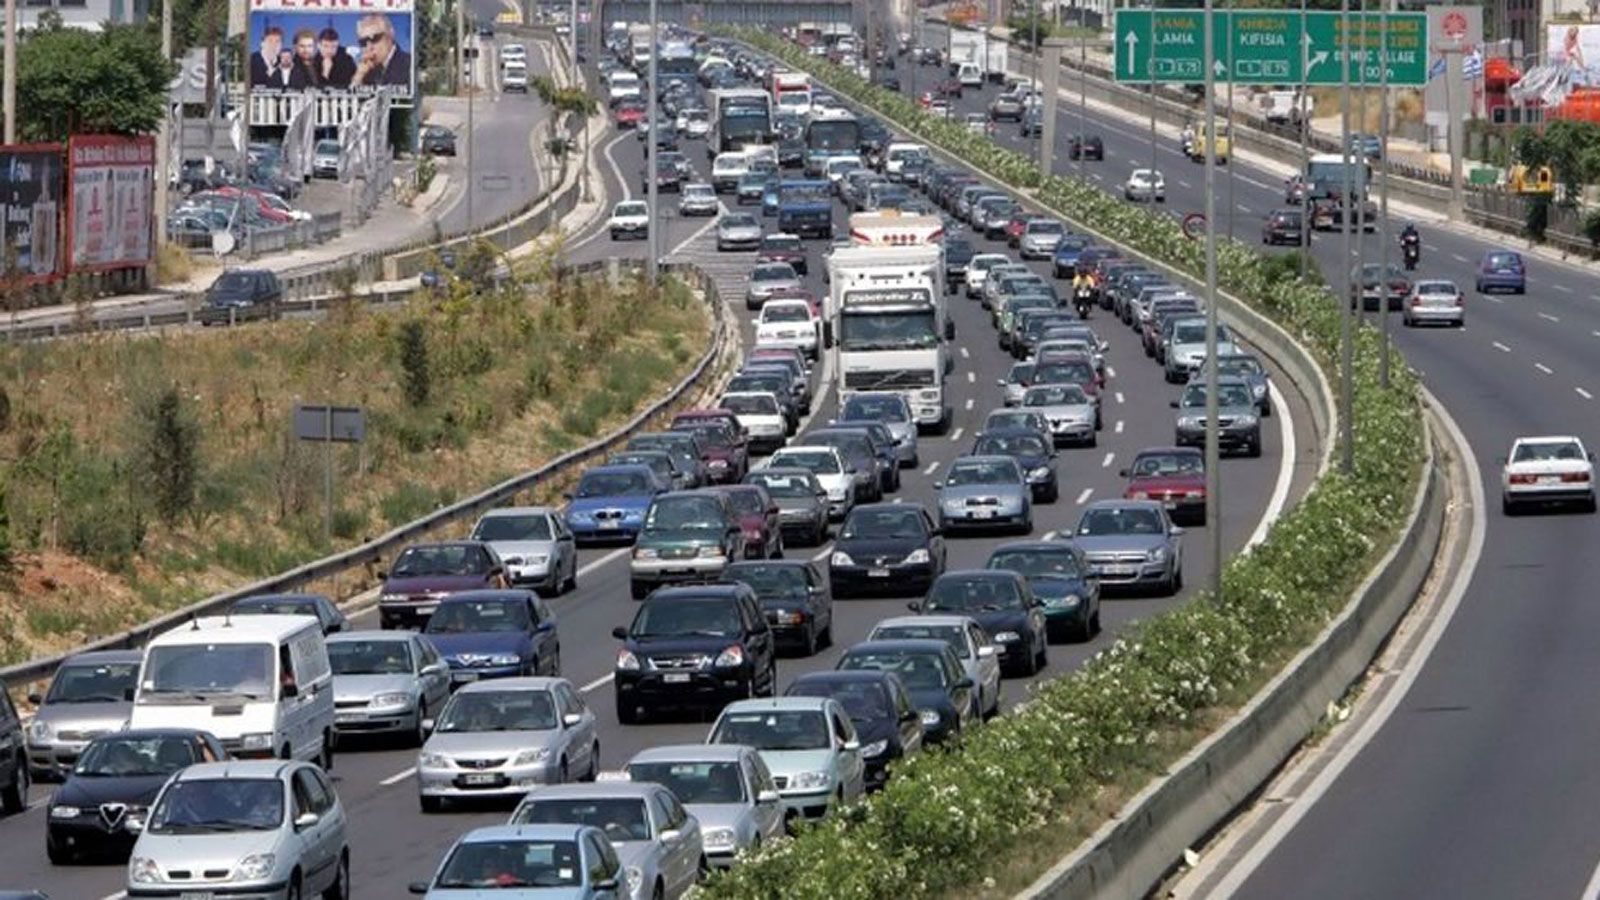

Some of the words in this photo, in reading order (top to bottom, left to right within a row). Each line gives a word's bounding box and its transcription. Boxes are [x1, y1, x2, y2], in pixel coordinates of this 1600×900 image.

[1152, 33, 1194, 44] LAMIA
[1240, 33, 1285, 45] KIFISIA
[1377, 50, 1415, 63] VLLAGE
